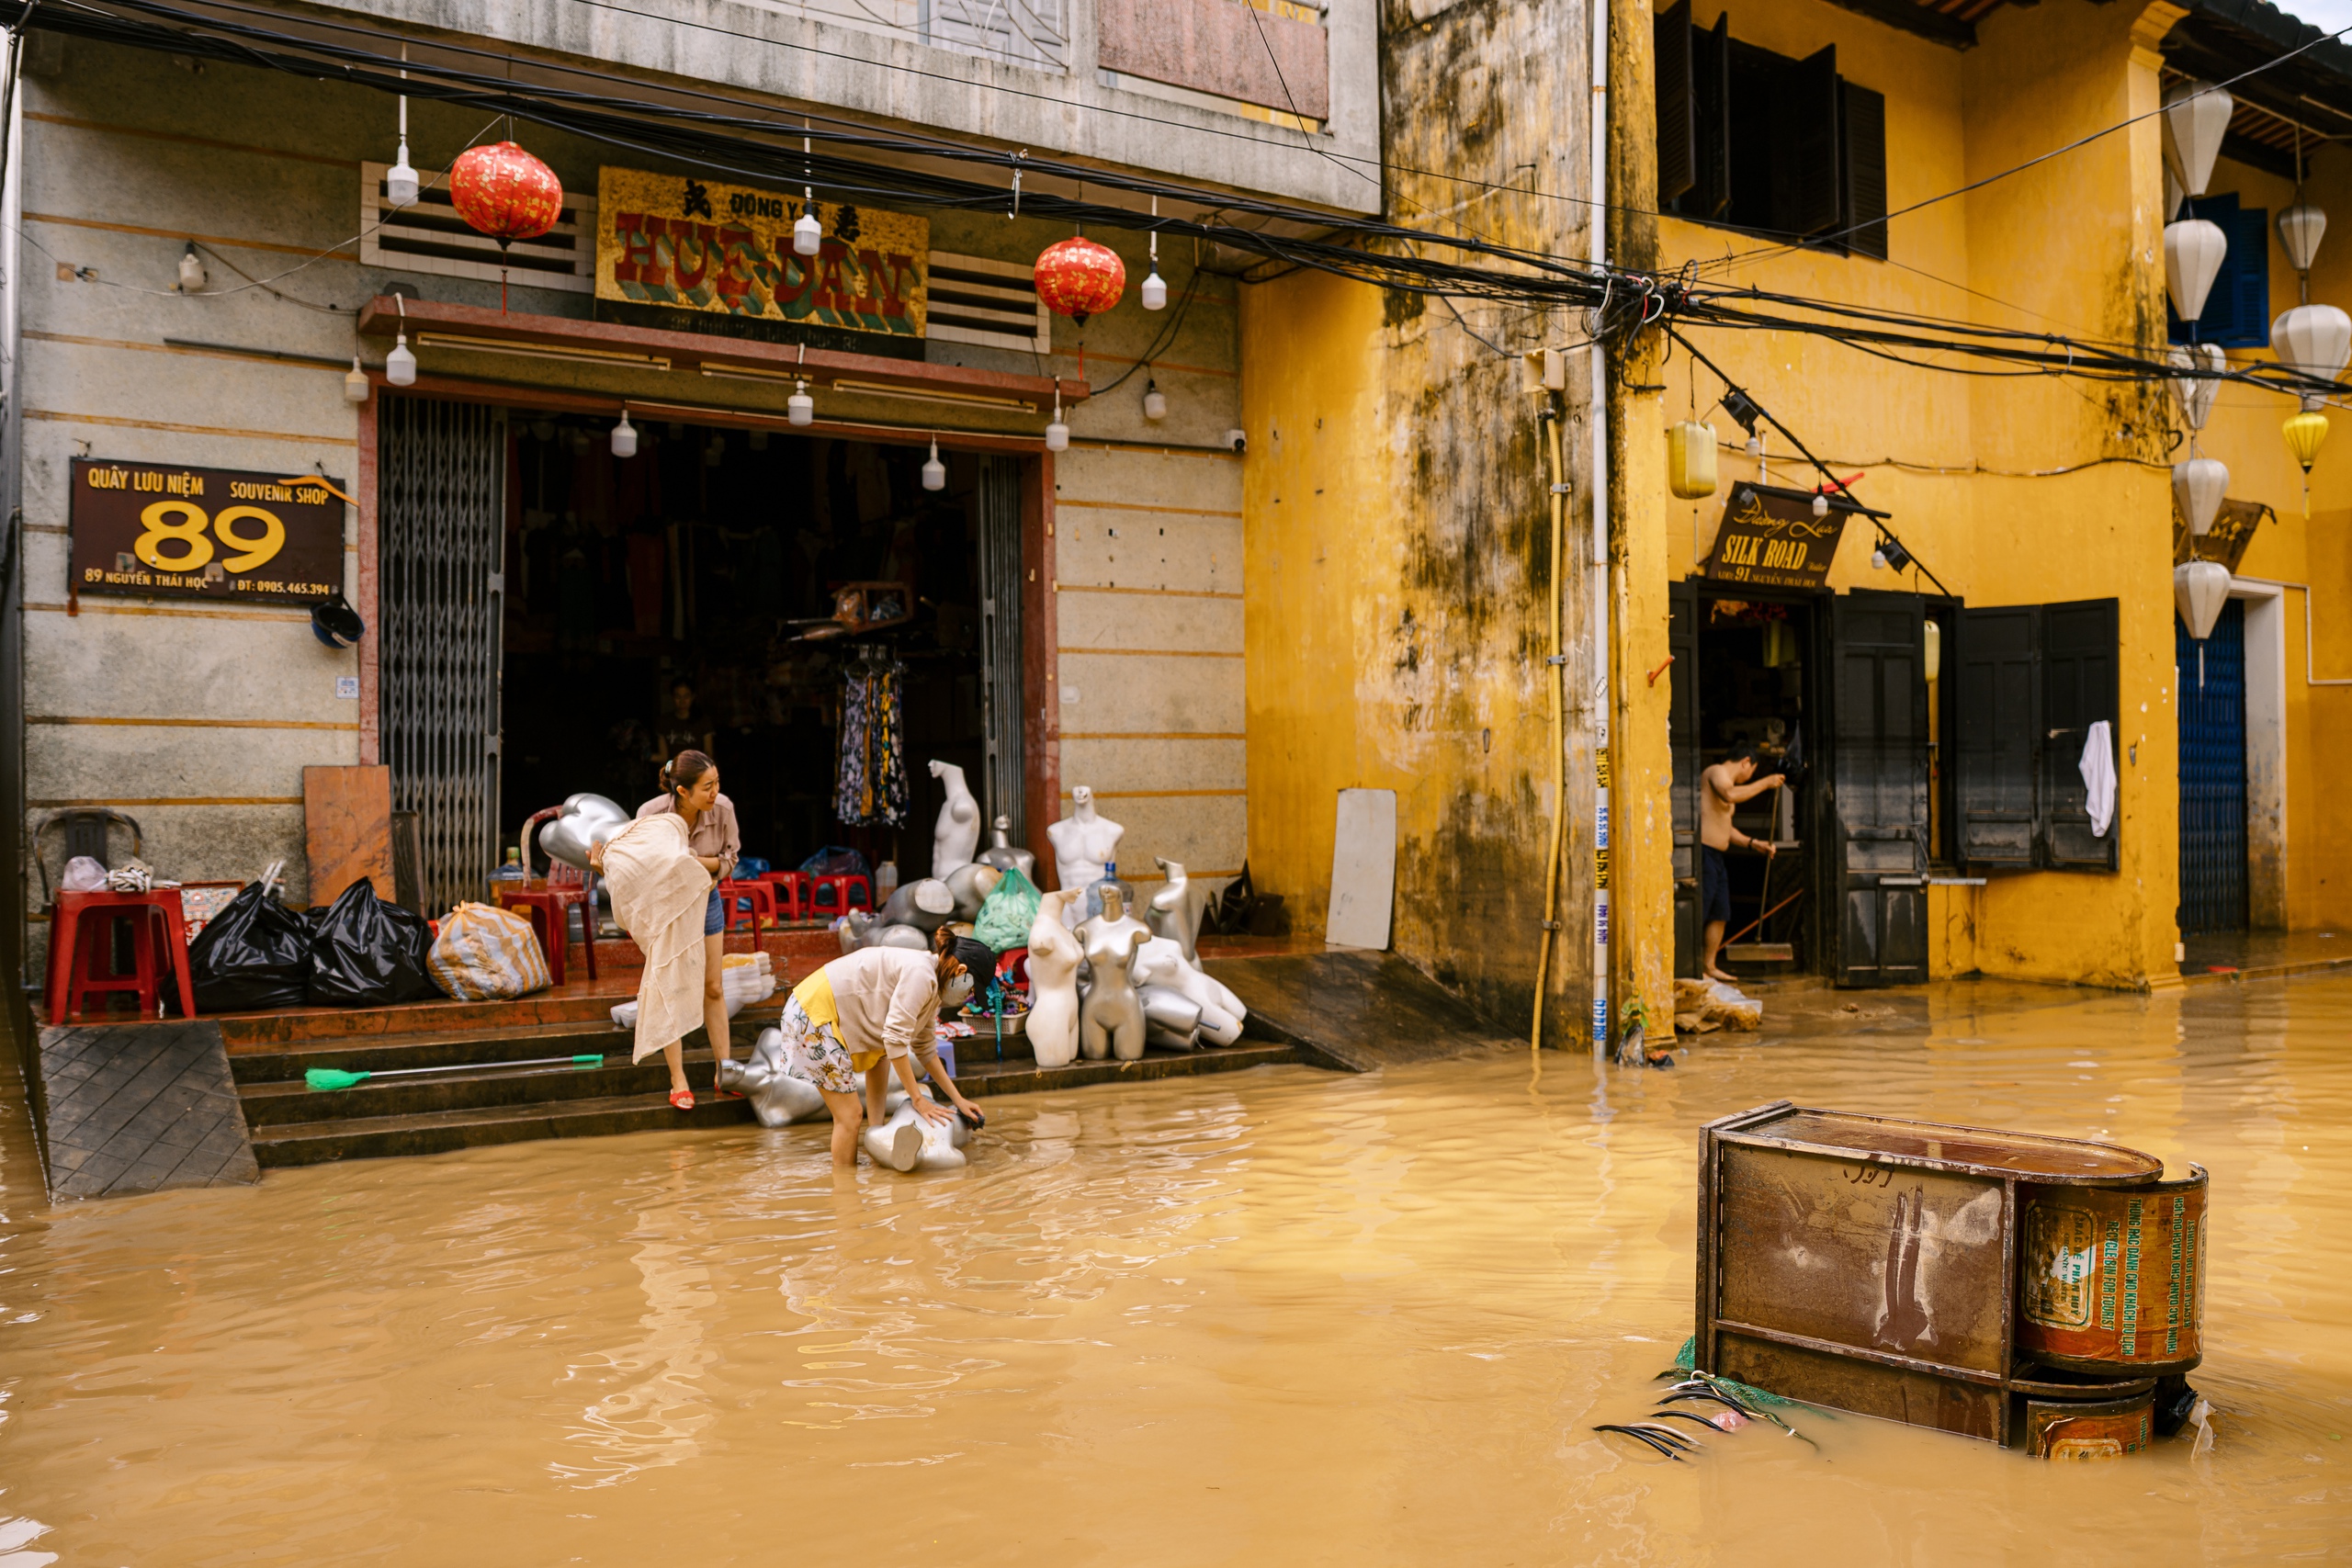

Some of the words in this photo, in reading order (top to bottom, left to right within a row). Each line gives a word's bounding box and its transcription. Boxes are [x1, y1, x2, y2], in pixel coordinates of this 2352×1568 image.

[787, 200, 798, 221] Y
[167, 471, 204, 498] NIỆM
[230, 480, 293, 503] SOUVENIR
[296, 487, 329, 505] SHOP
[134, 500, 286, 574] 89
[1721, 534, 1764, 567] SILK
[1761, 538, 1807, 570] ROAD
[85, 568, 103, 582] 89
[105, 570, 151, 586] NGUYỄN
[155, 573, 183, 587] THÁI
[1735, 566, 1751, 582] 91
[257, 581, 329, 596] 0905.465.394
[2128, 1198, 2144, 1226] THÙNG
[2173, 1217, 2183, 1231] DU
[2104, 1221, 2119, 1258] RECYCLE
[2169, 1232, 2182, 1261] KHÁCH
[2187, 1220, 2195, 1256] TOURIST
[2062, 1233, 2070, 1271] ORGANIC
[2125, 1247, 2142, 1271] DÀNH
[2103, 1259, 2117, 1275] BIN
[2170, 1261, 2181, 1280] CHO
[2186, 1256, 2194, 1273] FOR
[2102, 1276, 2117, 1293] FOR
[2167, 1280, 2180, 1306] DÀNH
[2185, 1274, 2193, 1291] BIN
[2100, 1294, 2116, 1330] TOURIST
[2123, 1292, 2139, 1321] KHÁCH
[2166, 1306, 2178, 1325] RÁC
[2183, 1292, 2192, 1328] RECYCLE
[2122, 1323, 2136, 1335] DU
[2119, 1336, 2135, 1356] LỊCH
